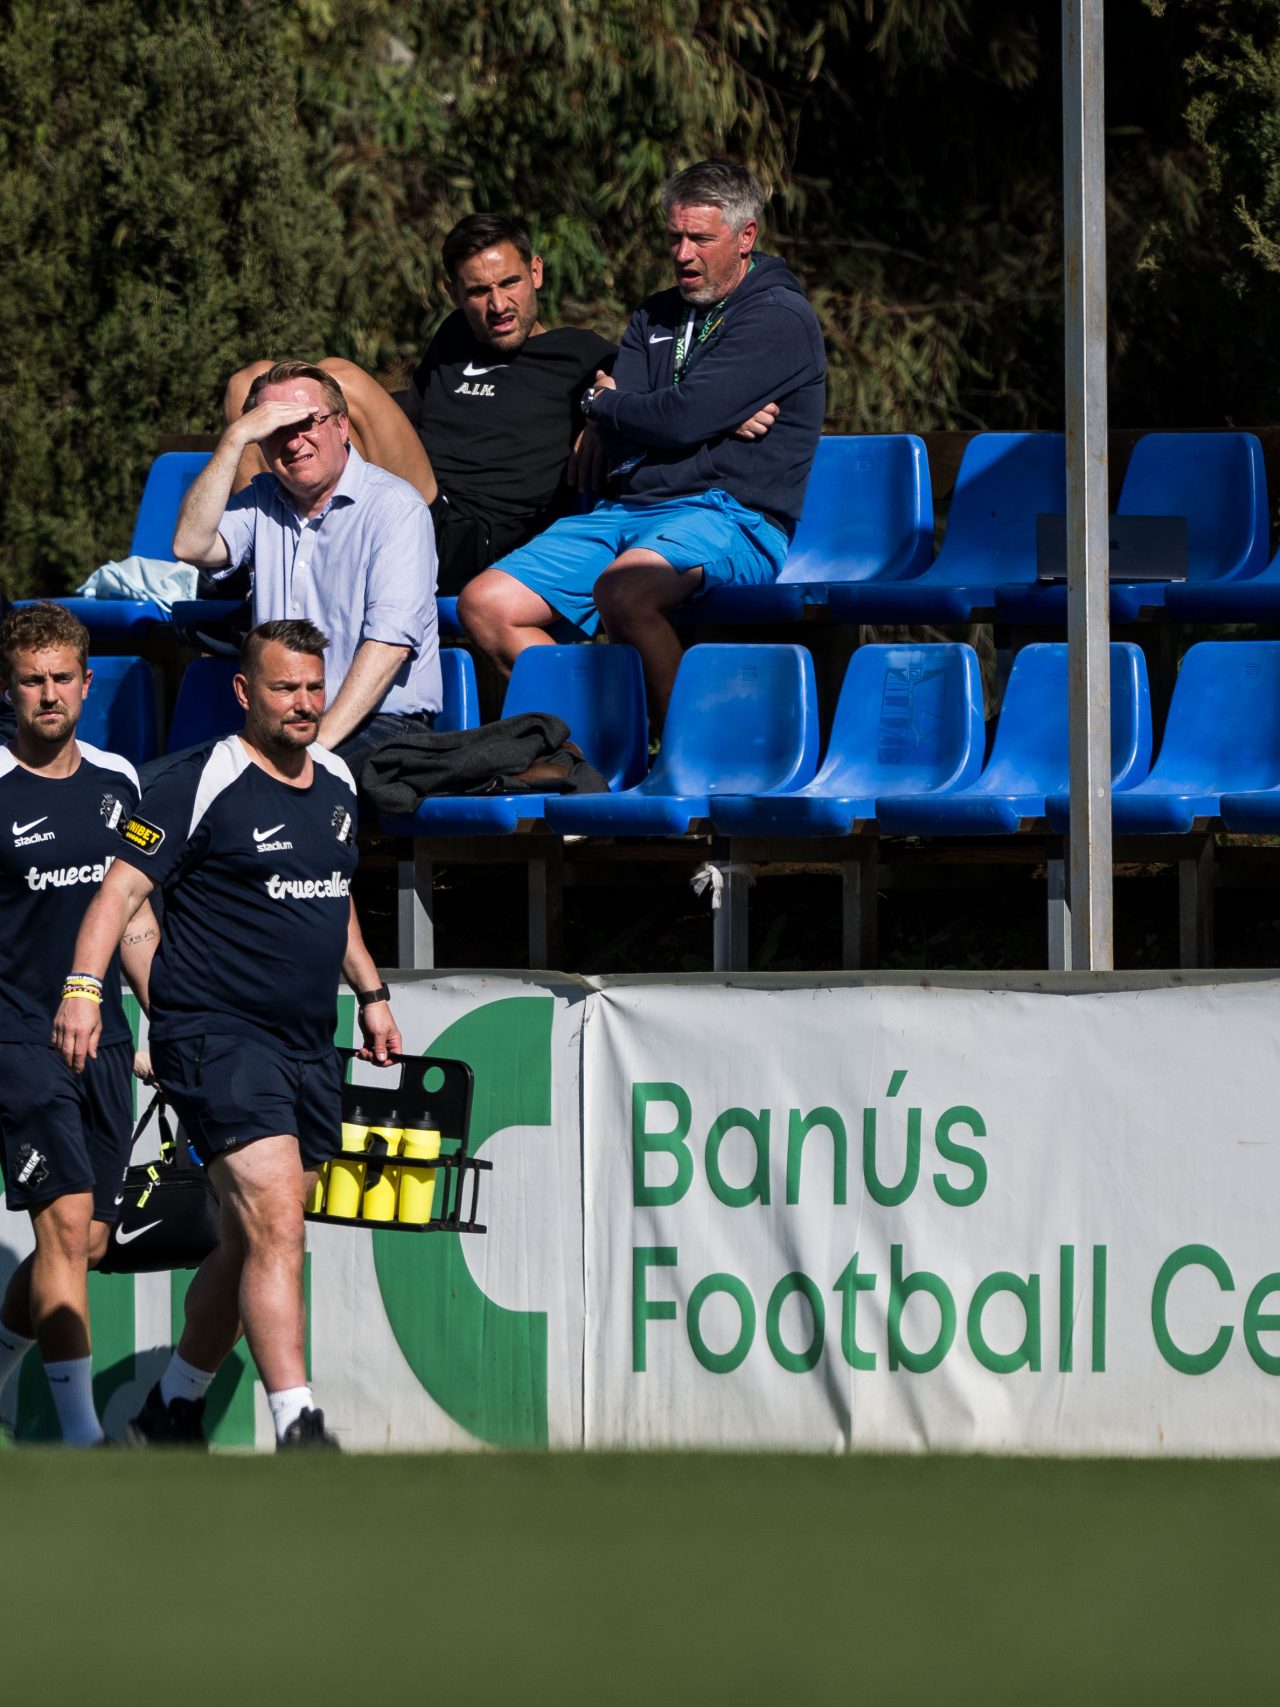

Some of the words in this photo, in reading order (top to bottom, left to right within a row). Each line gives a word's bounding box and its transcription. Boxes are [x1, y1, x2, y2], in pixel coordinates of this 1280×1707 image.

[454, 382, 496, 397] A.I.K.
[13, 831, 56, 848] stadium
[256, 840, 294, 853] stadium
[24, 855, 117, 891] truecal
[632, 1069, 989, 1208] Banús
[632, 1243, 1108, 1375] Football
